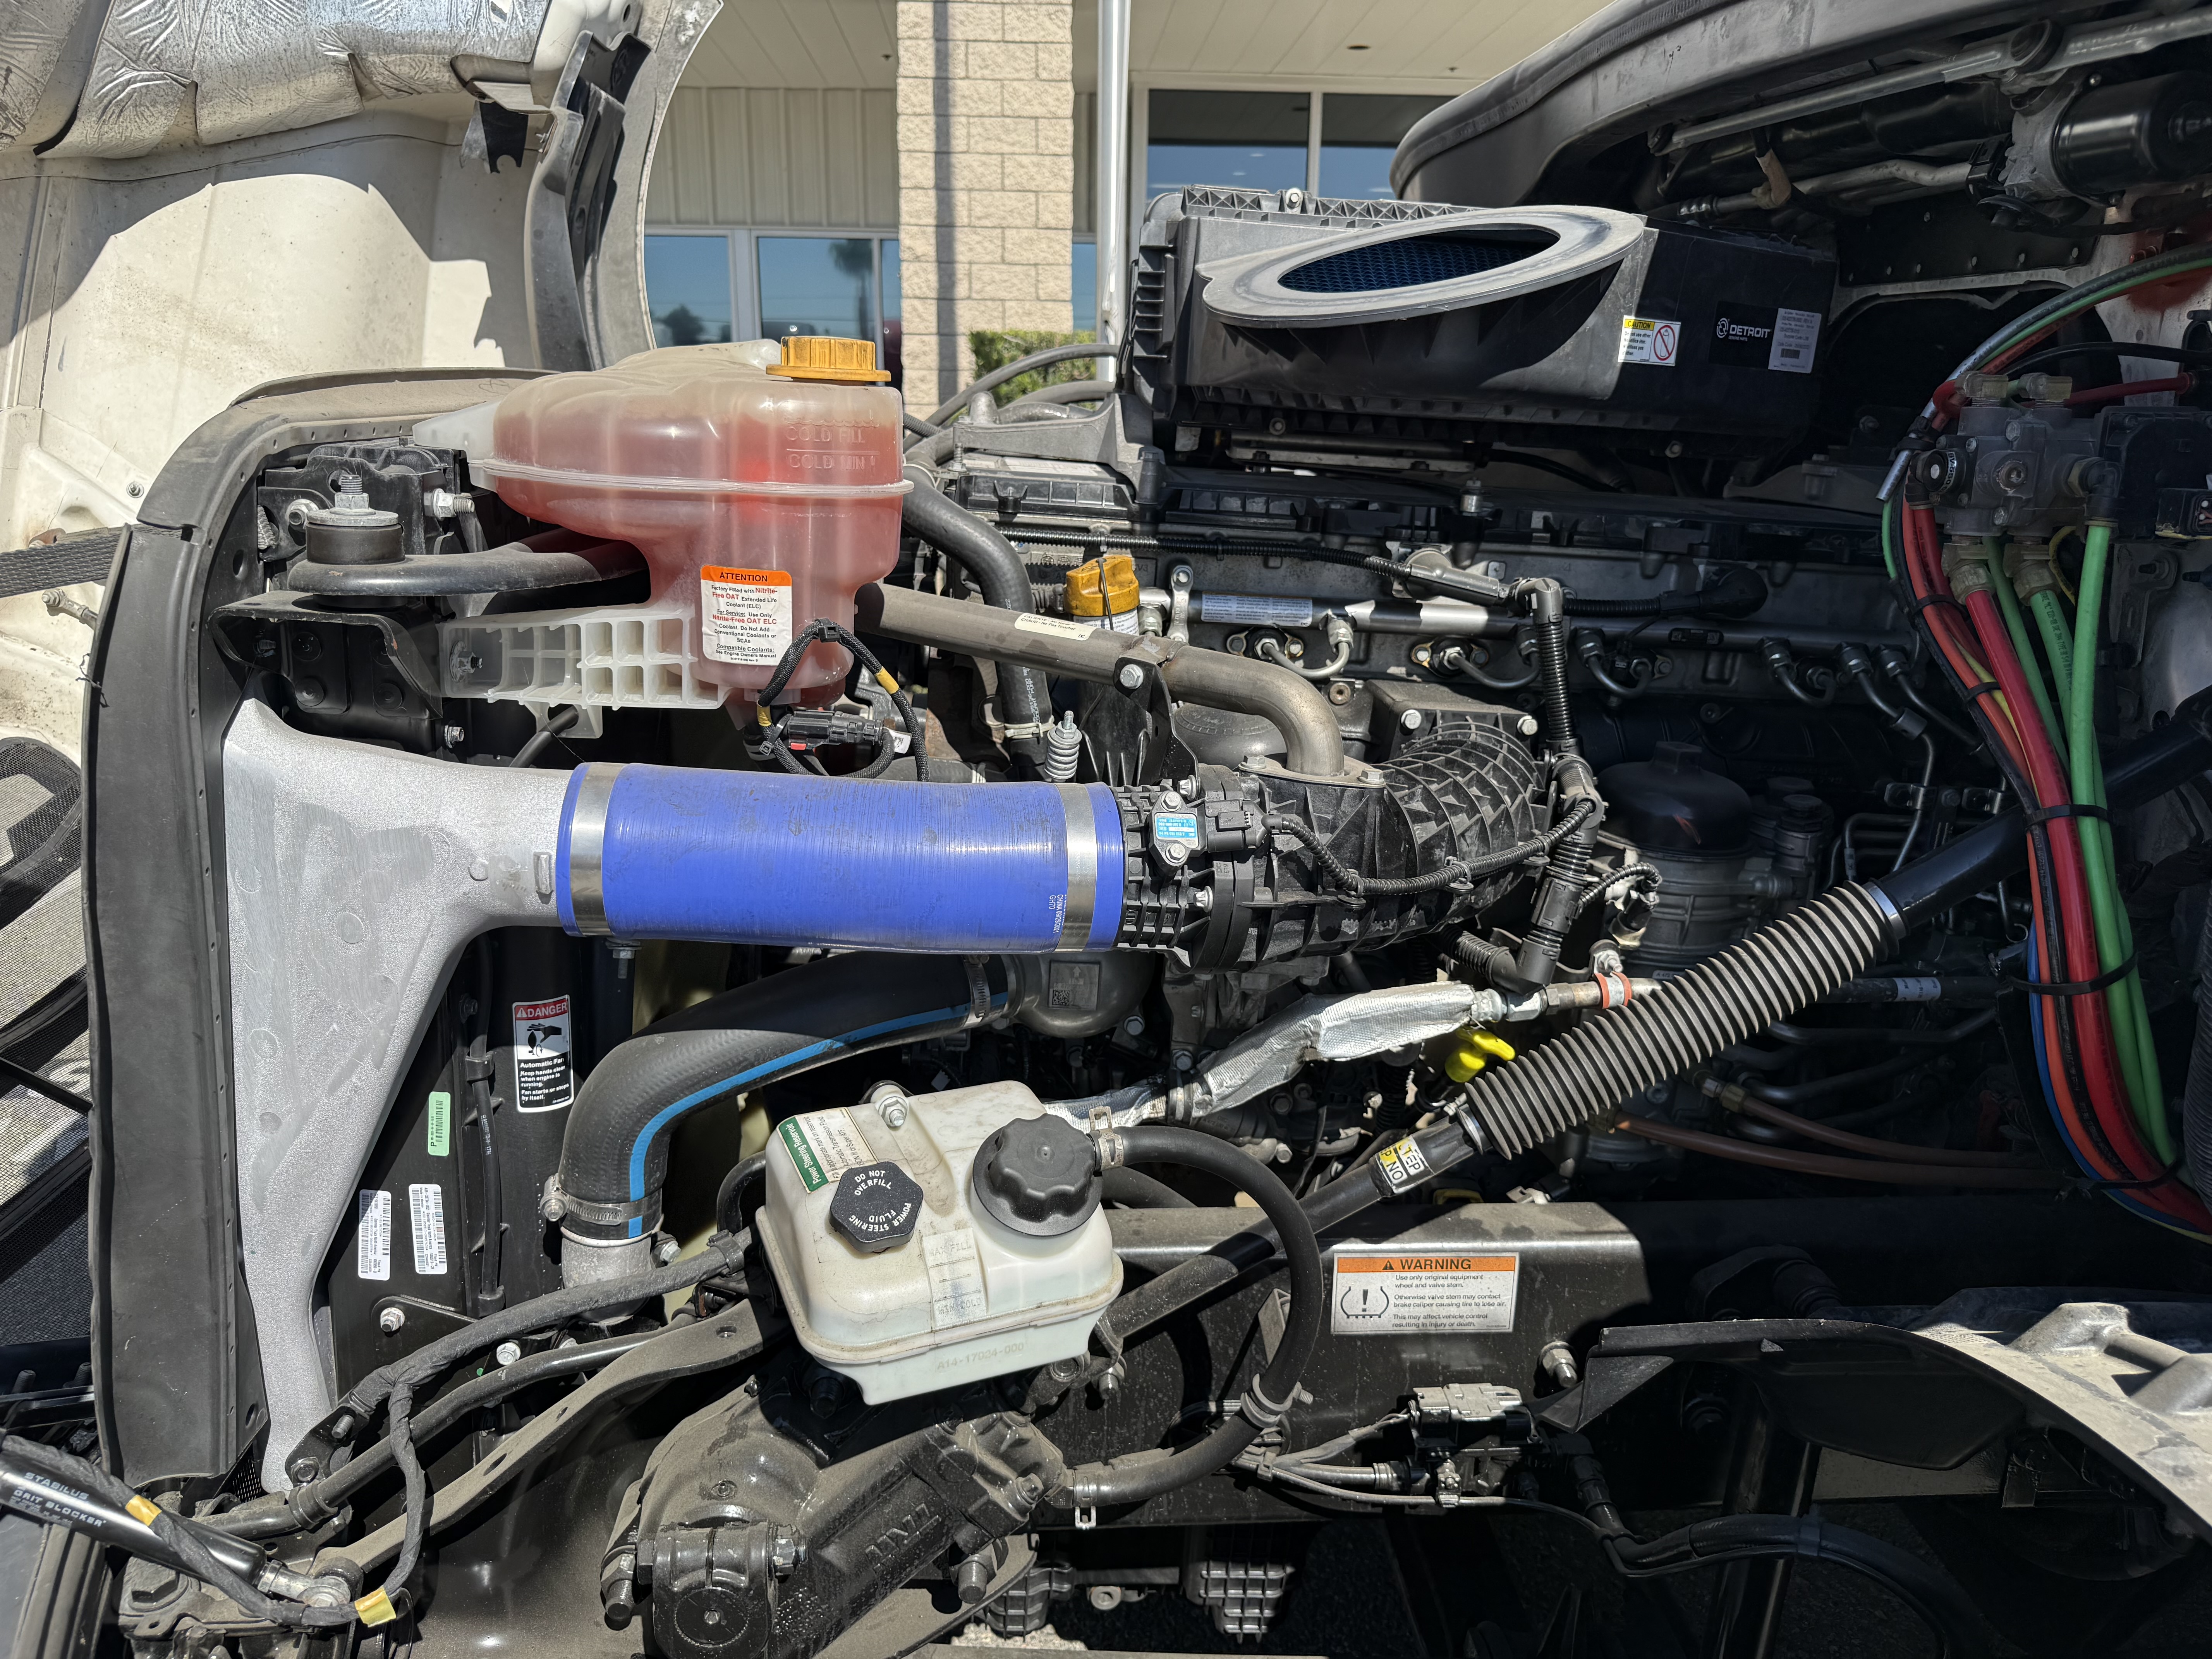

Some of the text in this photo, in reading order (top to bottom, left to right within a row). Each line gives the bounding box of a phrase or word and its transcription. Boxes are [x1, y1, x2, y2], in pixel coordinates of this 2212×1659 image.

[1729, 325, 1770, 338] DETROIT
[785, 426, 865, 443] COLD FILL
[789, 454, 864, 470] COLD MIN
[720, 572, 768, 582] ATTENTION
[713, 614, 745, 623] Nitrite-Free
[527, 1002, 567, 1017] DANGER
[556, 1083, 569, 1091] stops
[522, 1095, 529, 1103] by
[814, 1136, 824, 1148] mark
[817, 1115, 850, 1167] Automatic Transmission Fluid
[842, 1134, 854, 1147] Super
[786, 1123, 822, 1184] Power Steering Reservoir
[819, 1145, 837, 1169] appropriate
[854, 1173, 866, 1183] DO
[1386, 1161, 1403, 1180] NO
[854, 1178, 891, 1196] OVERFILL
[849, 1202, 912, 1232] POWER STEERING
[869, 1210, 896, 1223] FLUID
[951, 1241, 972, 1252] FILL
[1400, 1259, 1472, 1270] WARNING
[937, 1342, 1024, 1370] A14-17024-000
[24, 1472, 89, 1501] STABILUS
[13, 1489, 43, 1503] GRIT
[45, 1501, 103, 1527] BLOCKER
